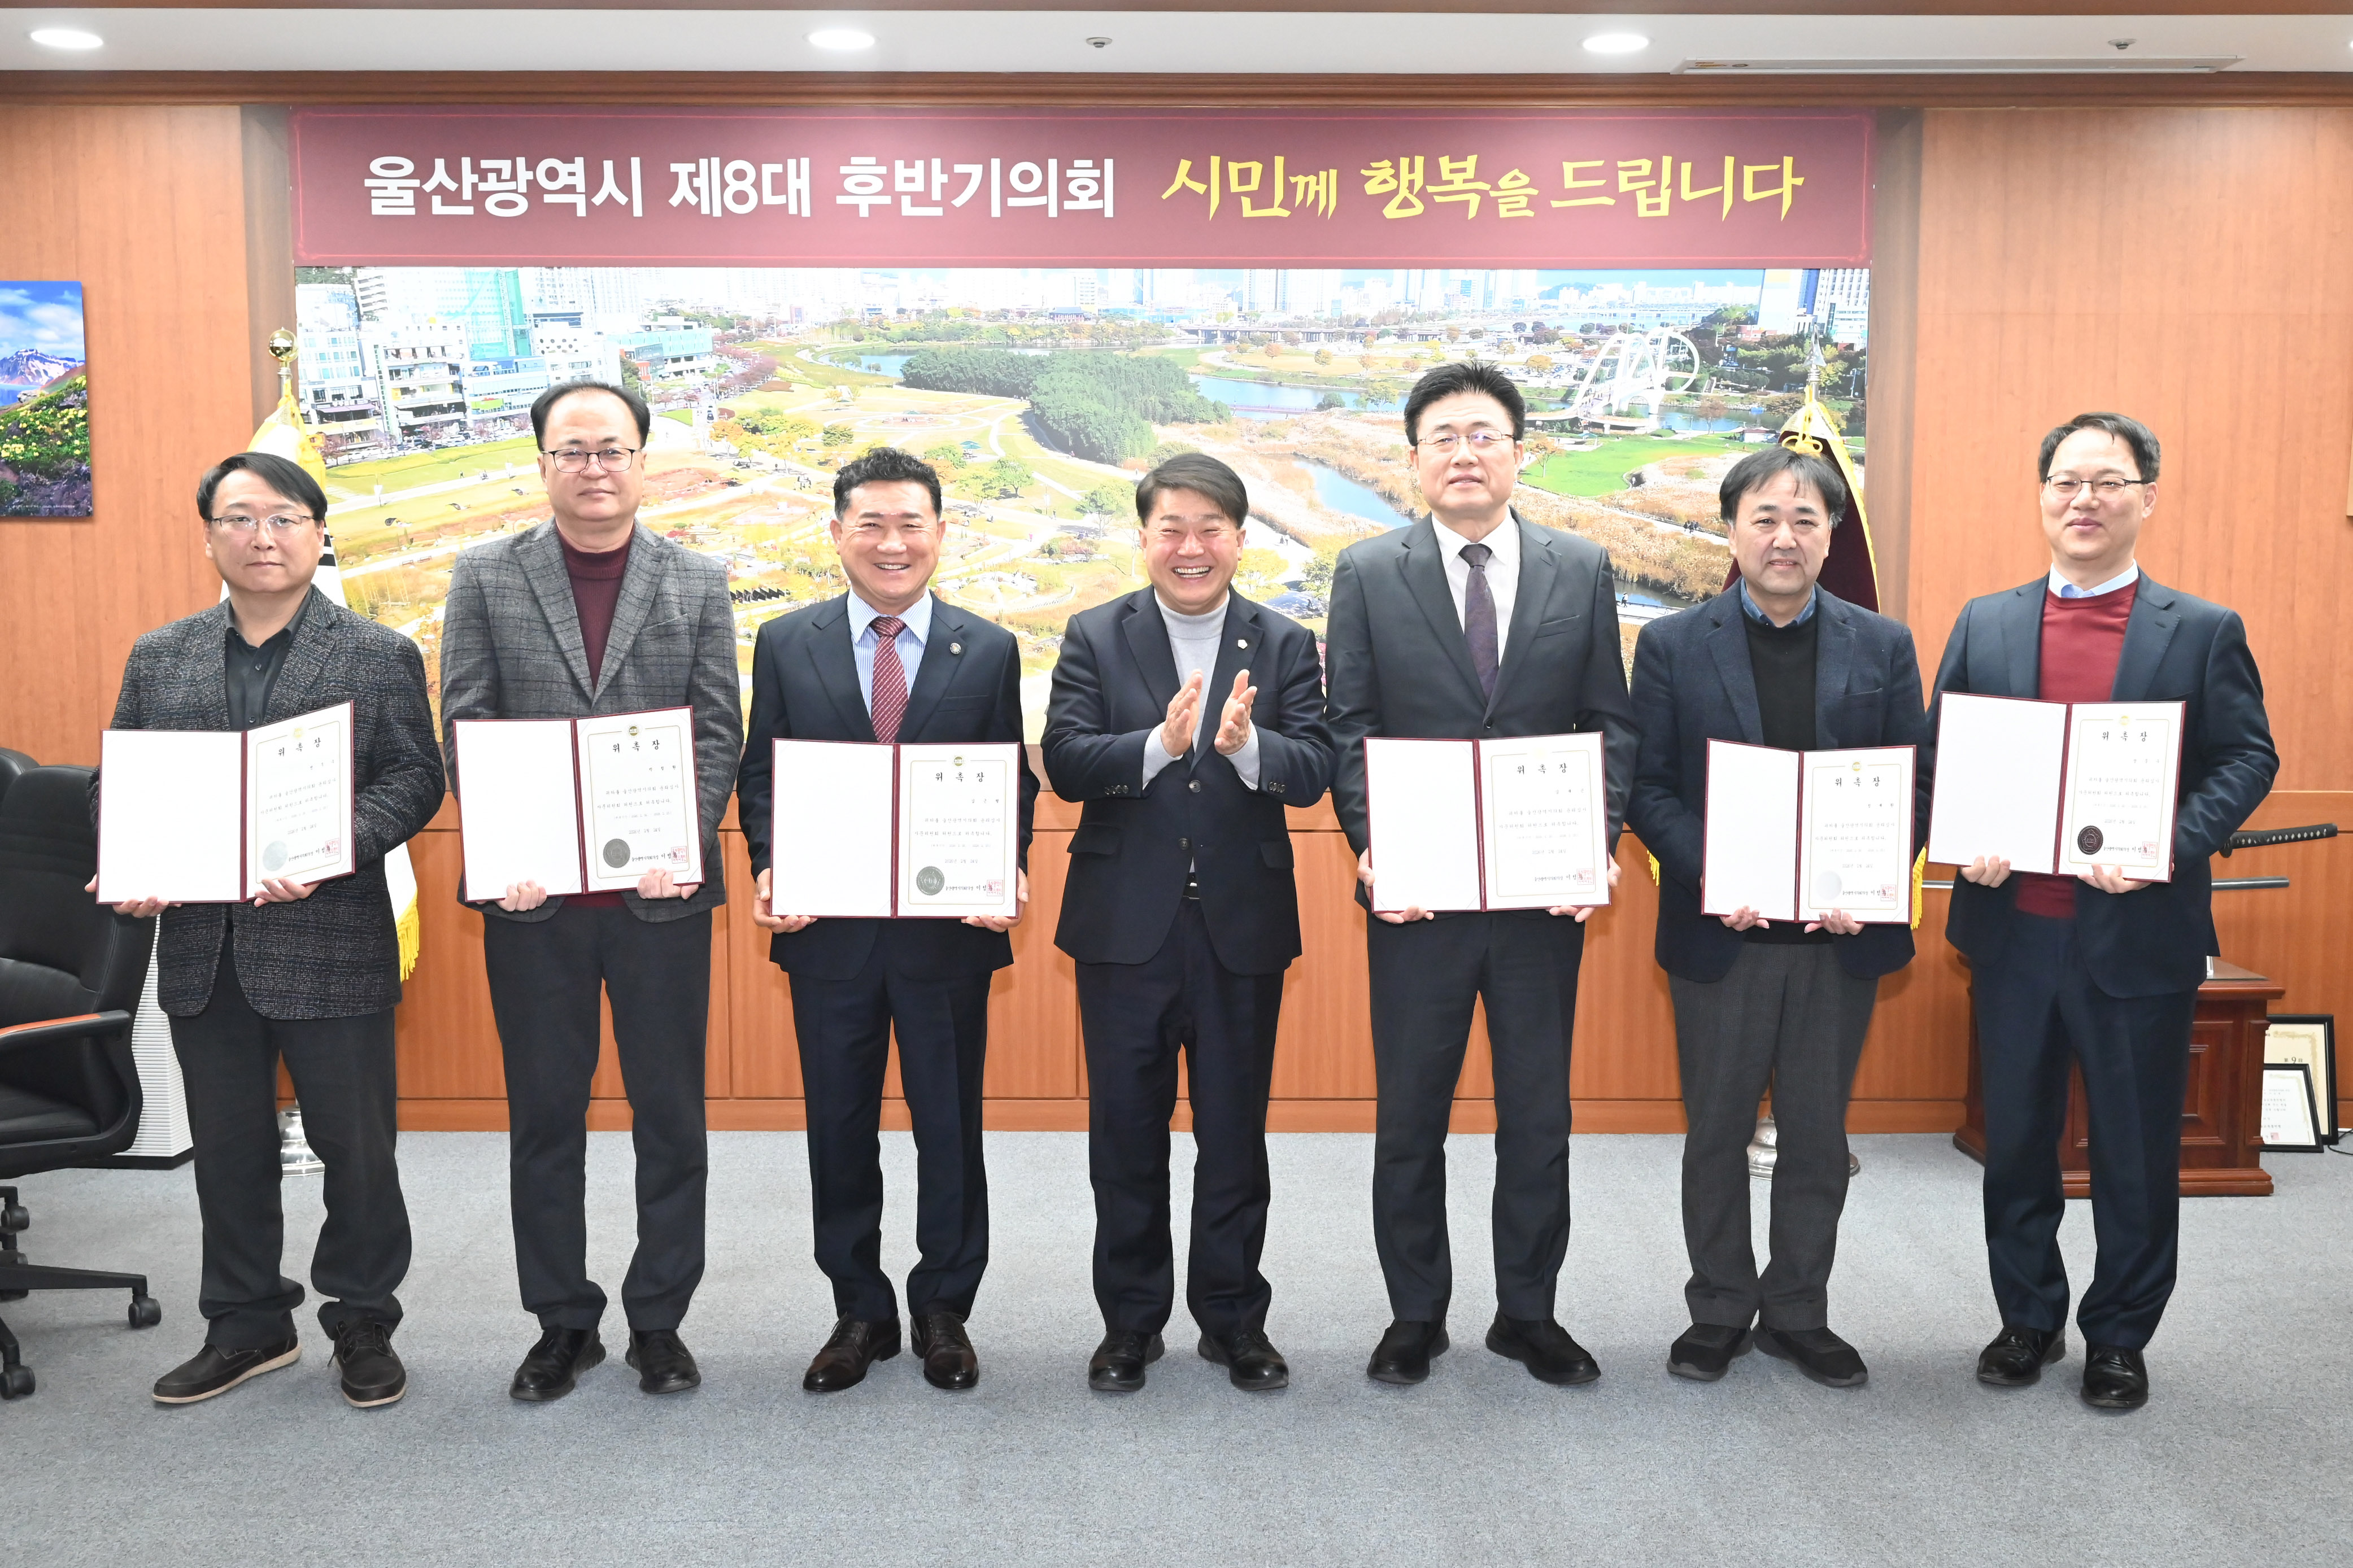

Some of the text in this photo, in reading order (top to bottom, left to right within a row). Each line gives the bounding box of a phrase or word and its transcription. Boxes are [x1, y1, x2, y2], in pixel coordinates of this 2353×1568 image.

[364, 154, 1805, 222] 울산광역시 제8대 후반기의회 시민께 행복을 드립니다
